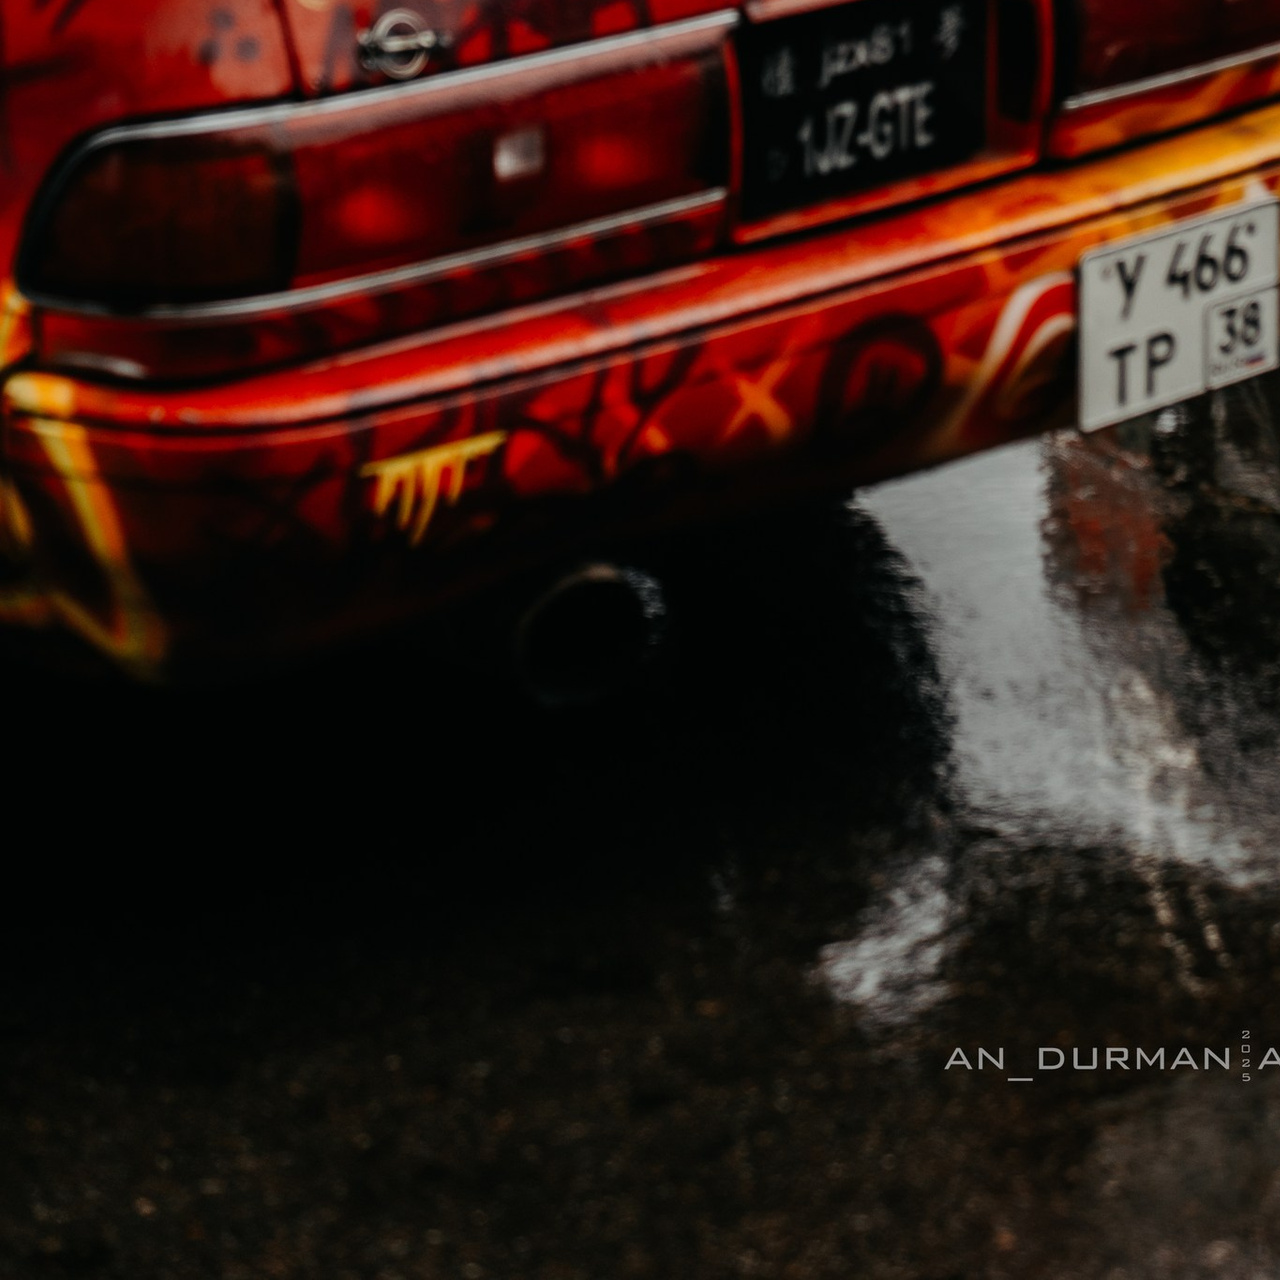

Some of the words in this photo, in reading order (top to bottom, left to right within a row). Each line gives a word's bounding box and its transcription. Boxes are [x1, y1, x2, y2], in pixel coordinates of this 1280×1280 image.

[799, 80, 935, 178] 1JZ-GTE
[1165, 222, 1249, 302] 466
[1108, 332, 1176, 406] ТР
[1219, 300, 1261, 356] 38
